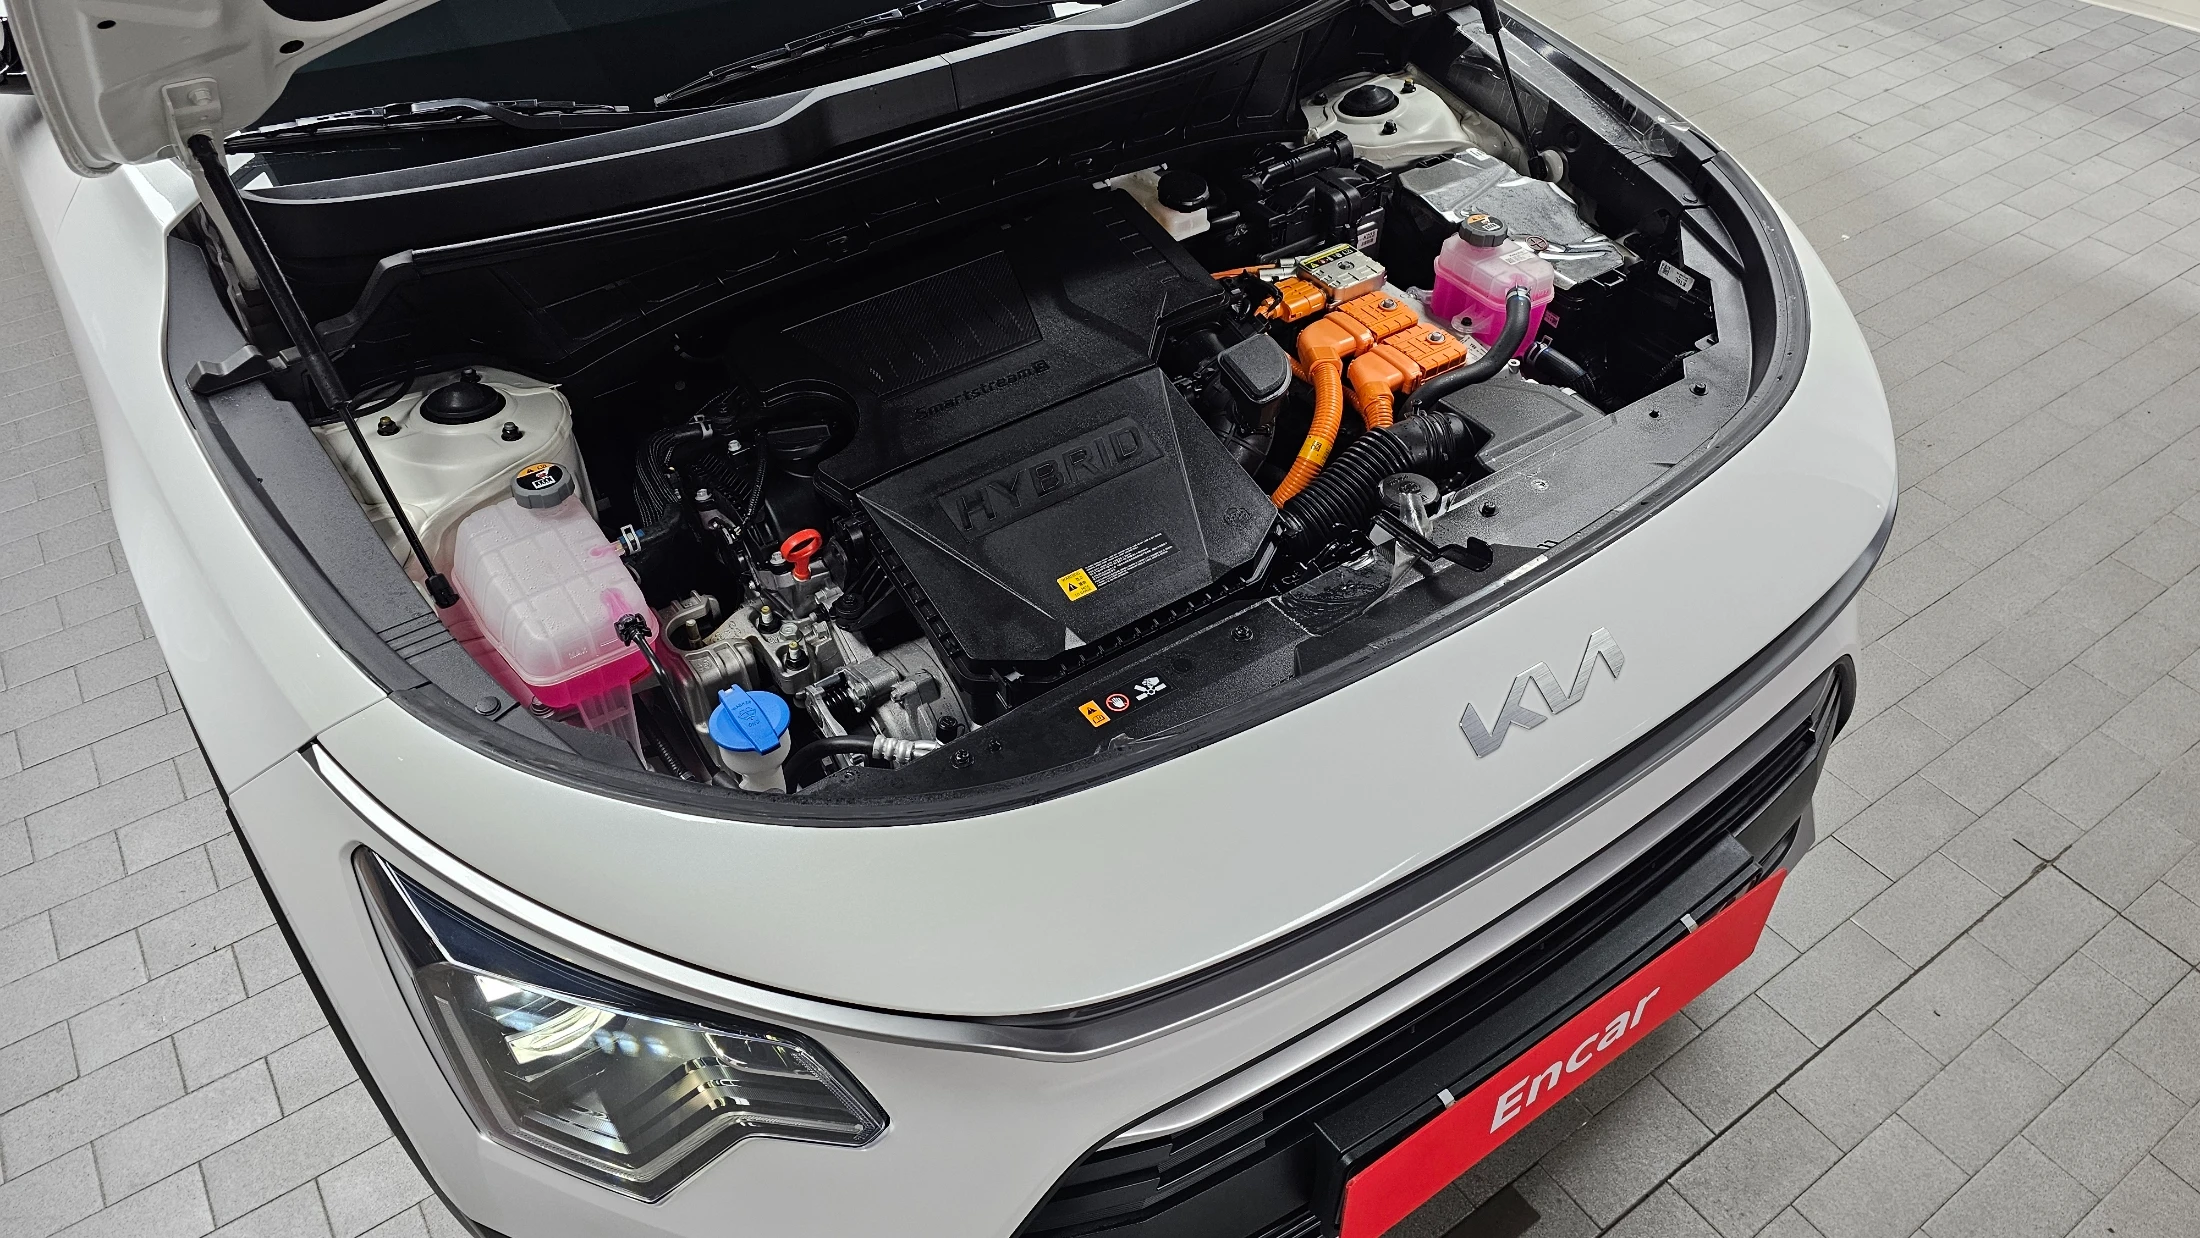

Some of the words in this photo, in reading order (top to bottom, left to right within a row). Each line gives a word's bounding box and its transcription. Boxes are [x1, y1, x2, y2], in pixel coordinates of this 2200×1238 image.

[912, 367, 1032, 422] Smartstream
[956, 426, 1144, 531] HYBRID
[1459, 626, 1625, 758] KIA
[1490, 986, 1661, 1134] Encar
